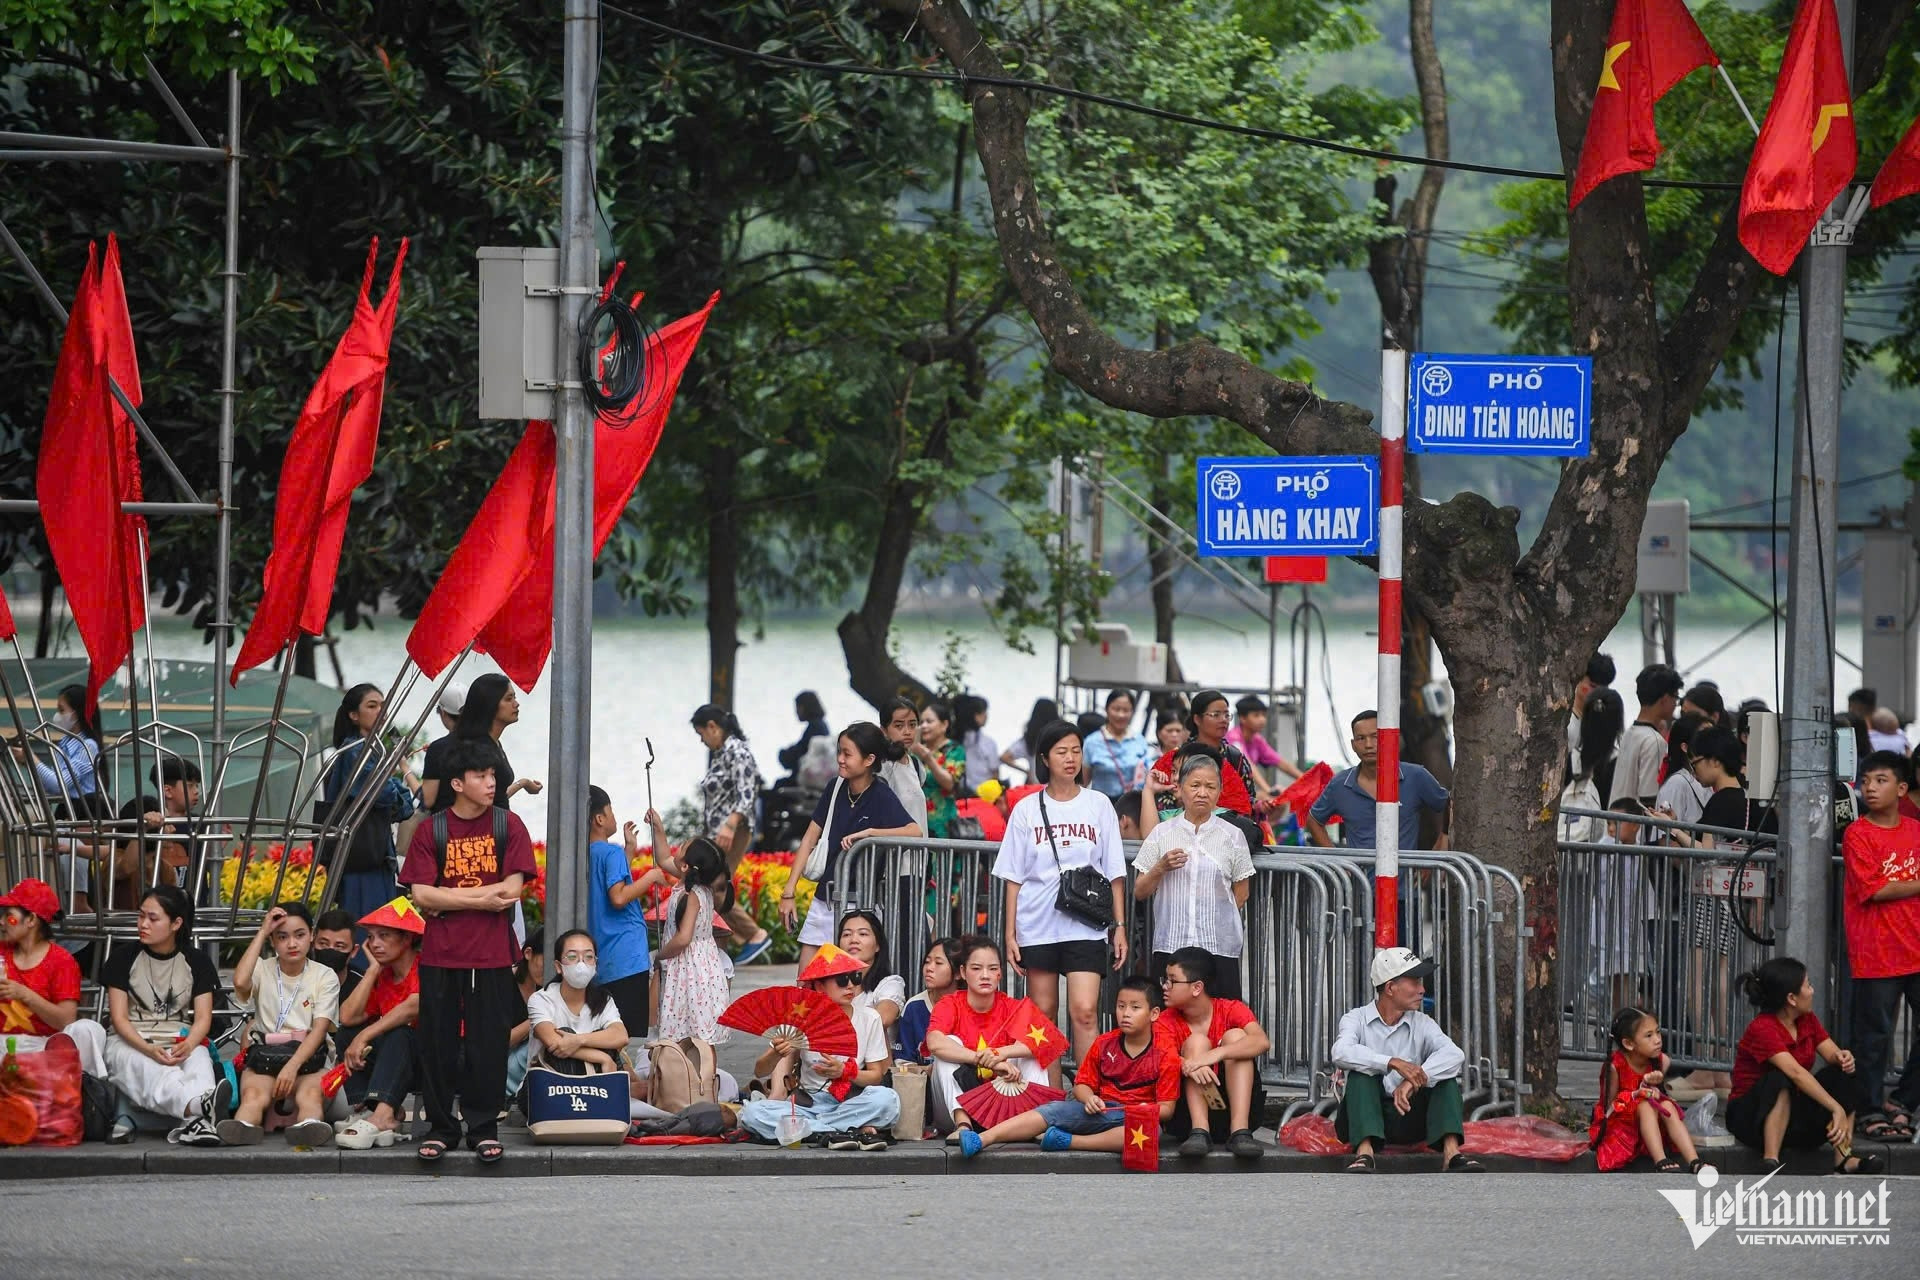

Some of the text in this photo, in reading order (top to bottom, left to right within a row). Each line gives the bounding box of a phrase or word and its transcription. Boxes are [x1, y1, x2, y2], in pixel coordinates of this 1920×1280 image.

[1488, 367, 1545, 390] PHỐ
[1424, 400, 1574, 440] ĐINH TIÊN HOÀNG
[1276, 469, 1330, 493] PHỐ
[1217, 502, 1362, 541] HÀNG KHAY
[1034, 823, 1097, 845] VIETNAM
[1722, 880, 1754, 892] SOP
[547, 1085, 609, 1099] DODGERS
[570, 1094, 588, 1111] LA
